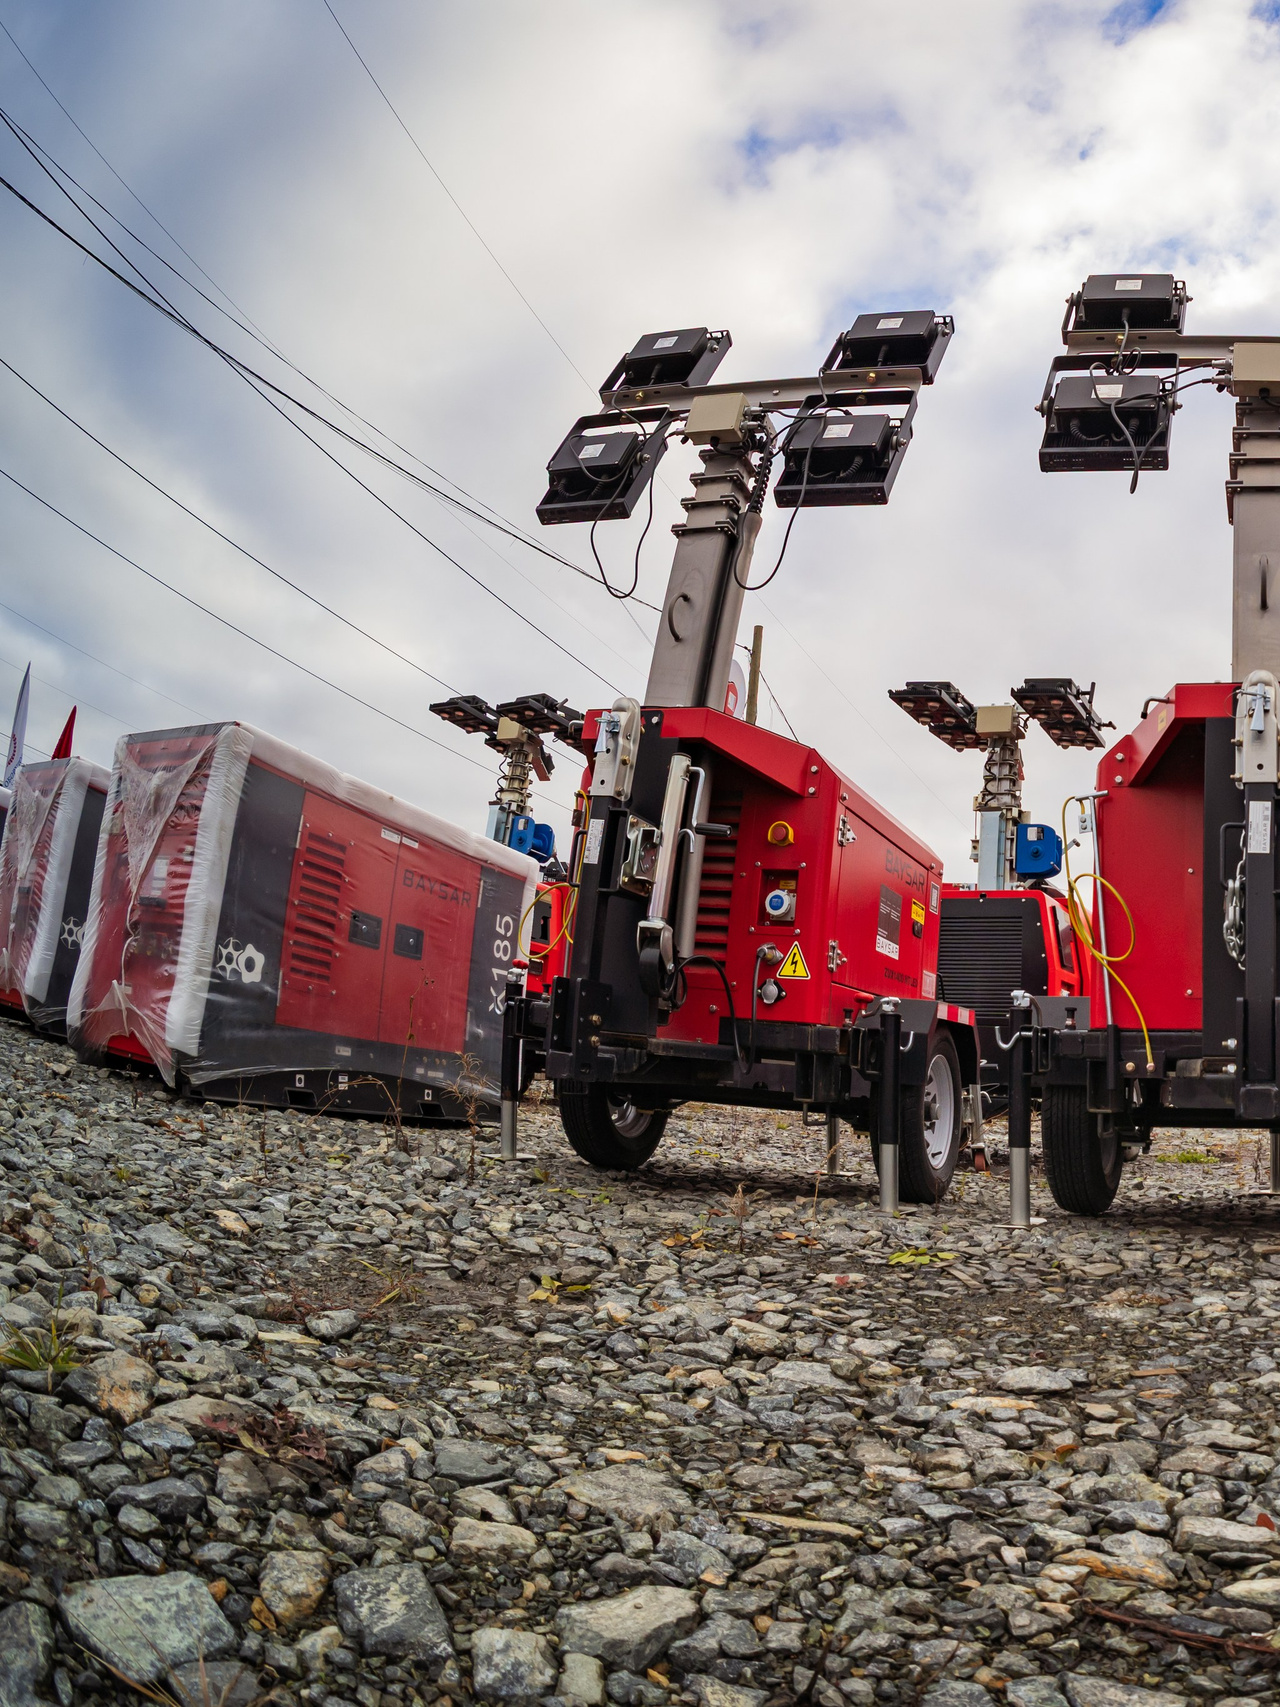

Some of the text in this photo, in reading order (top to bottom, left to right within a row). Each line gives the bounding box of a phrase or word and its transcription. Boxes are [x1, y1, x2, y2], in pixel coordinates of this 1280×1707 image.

[402, 869, 472, 908] BAYSAR
[885, 849, 925, 894] BAYSAR
[488, 914, 514, 1012] X185
[876, 937, 898, 954] BAYSAR
